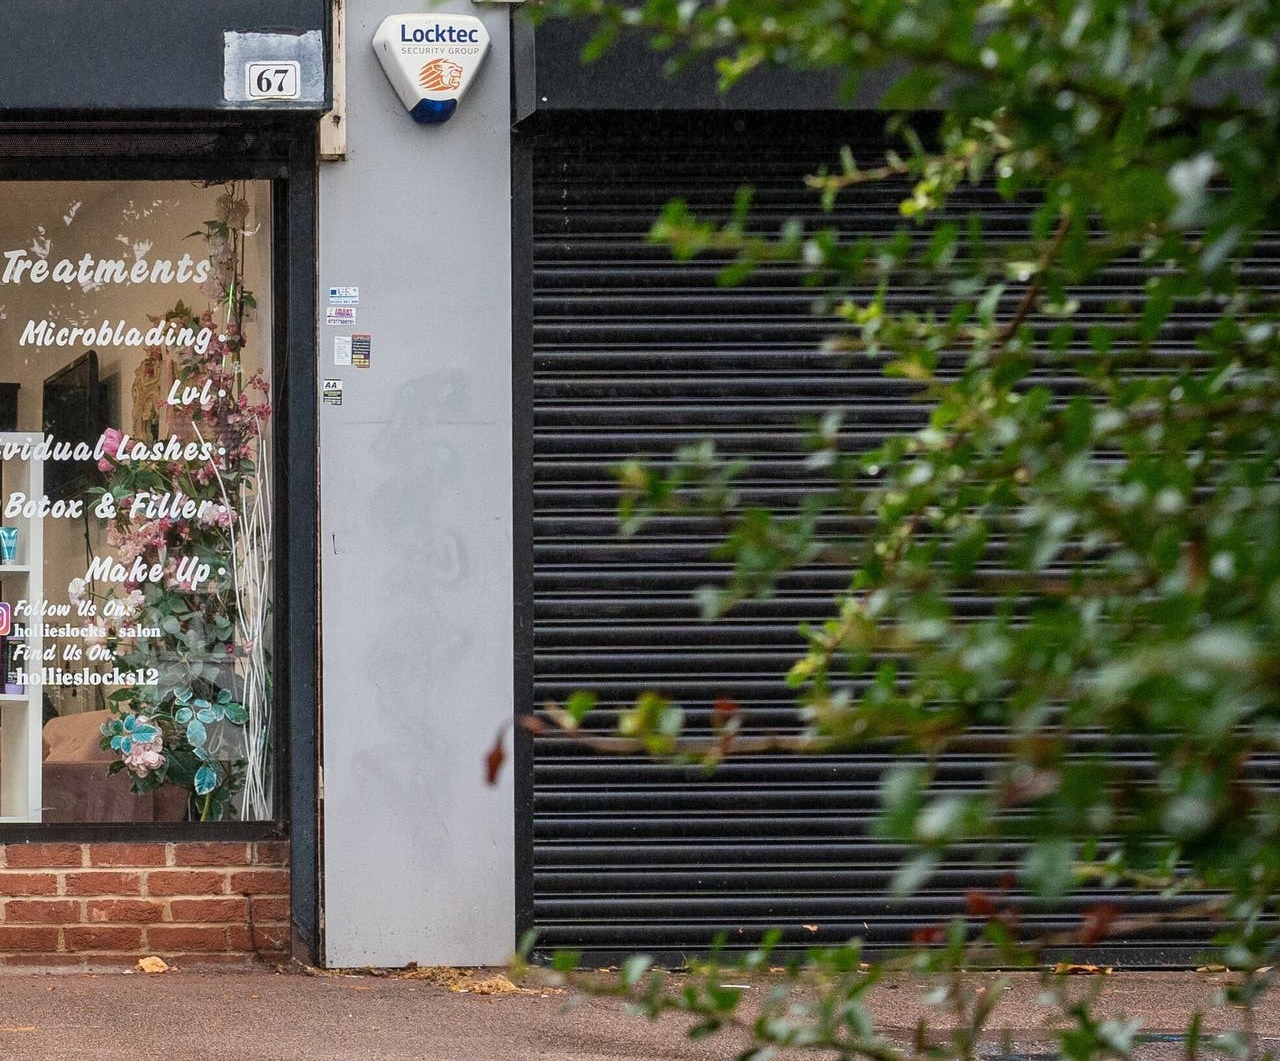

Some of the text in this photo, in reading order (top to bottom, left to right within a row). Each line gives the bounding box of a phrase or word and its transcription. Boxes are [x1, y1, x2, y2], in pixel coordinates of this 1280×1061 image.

[401, 24, 479, 43] Locktec
[401, 47, 479, 55] SECURITY GROUP
[256, 68, 289, 93] 67
[2, 250, 210, 285] Treatments
[19, 320, 211, 354] Microblading
[167, 379, 211, 405] Lvl
[115, 435, 213, 462] Lashes
[3, 492, 213, 520] Botox & Filler
[84, 556, 211, 590] Make Up
[13, 600, 72, 617] Follow
[78, 600, 97, 616] Us
[13, 644, 118, 662] Find Us On:
[16, 667, 159, 686] hollieslocks12
